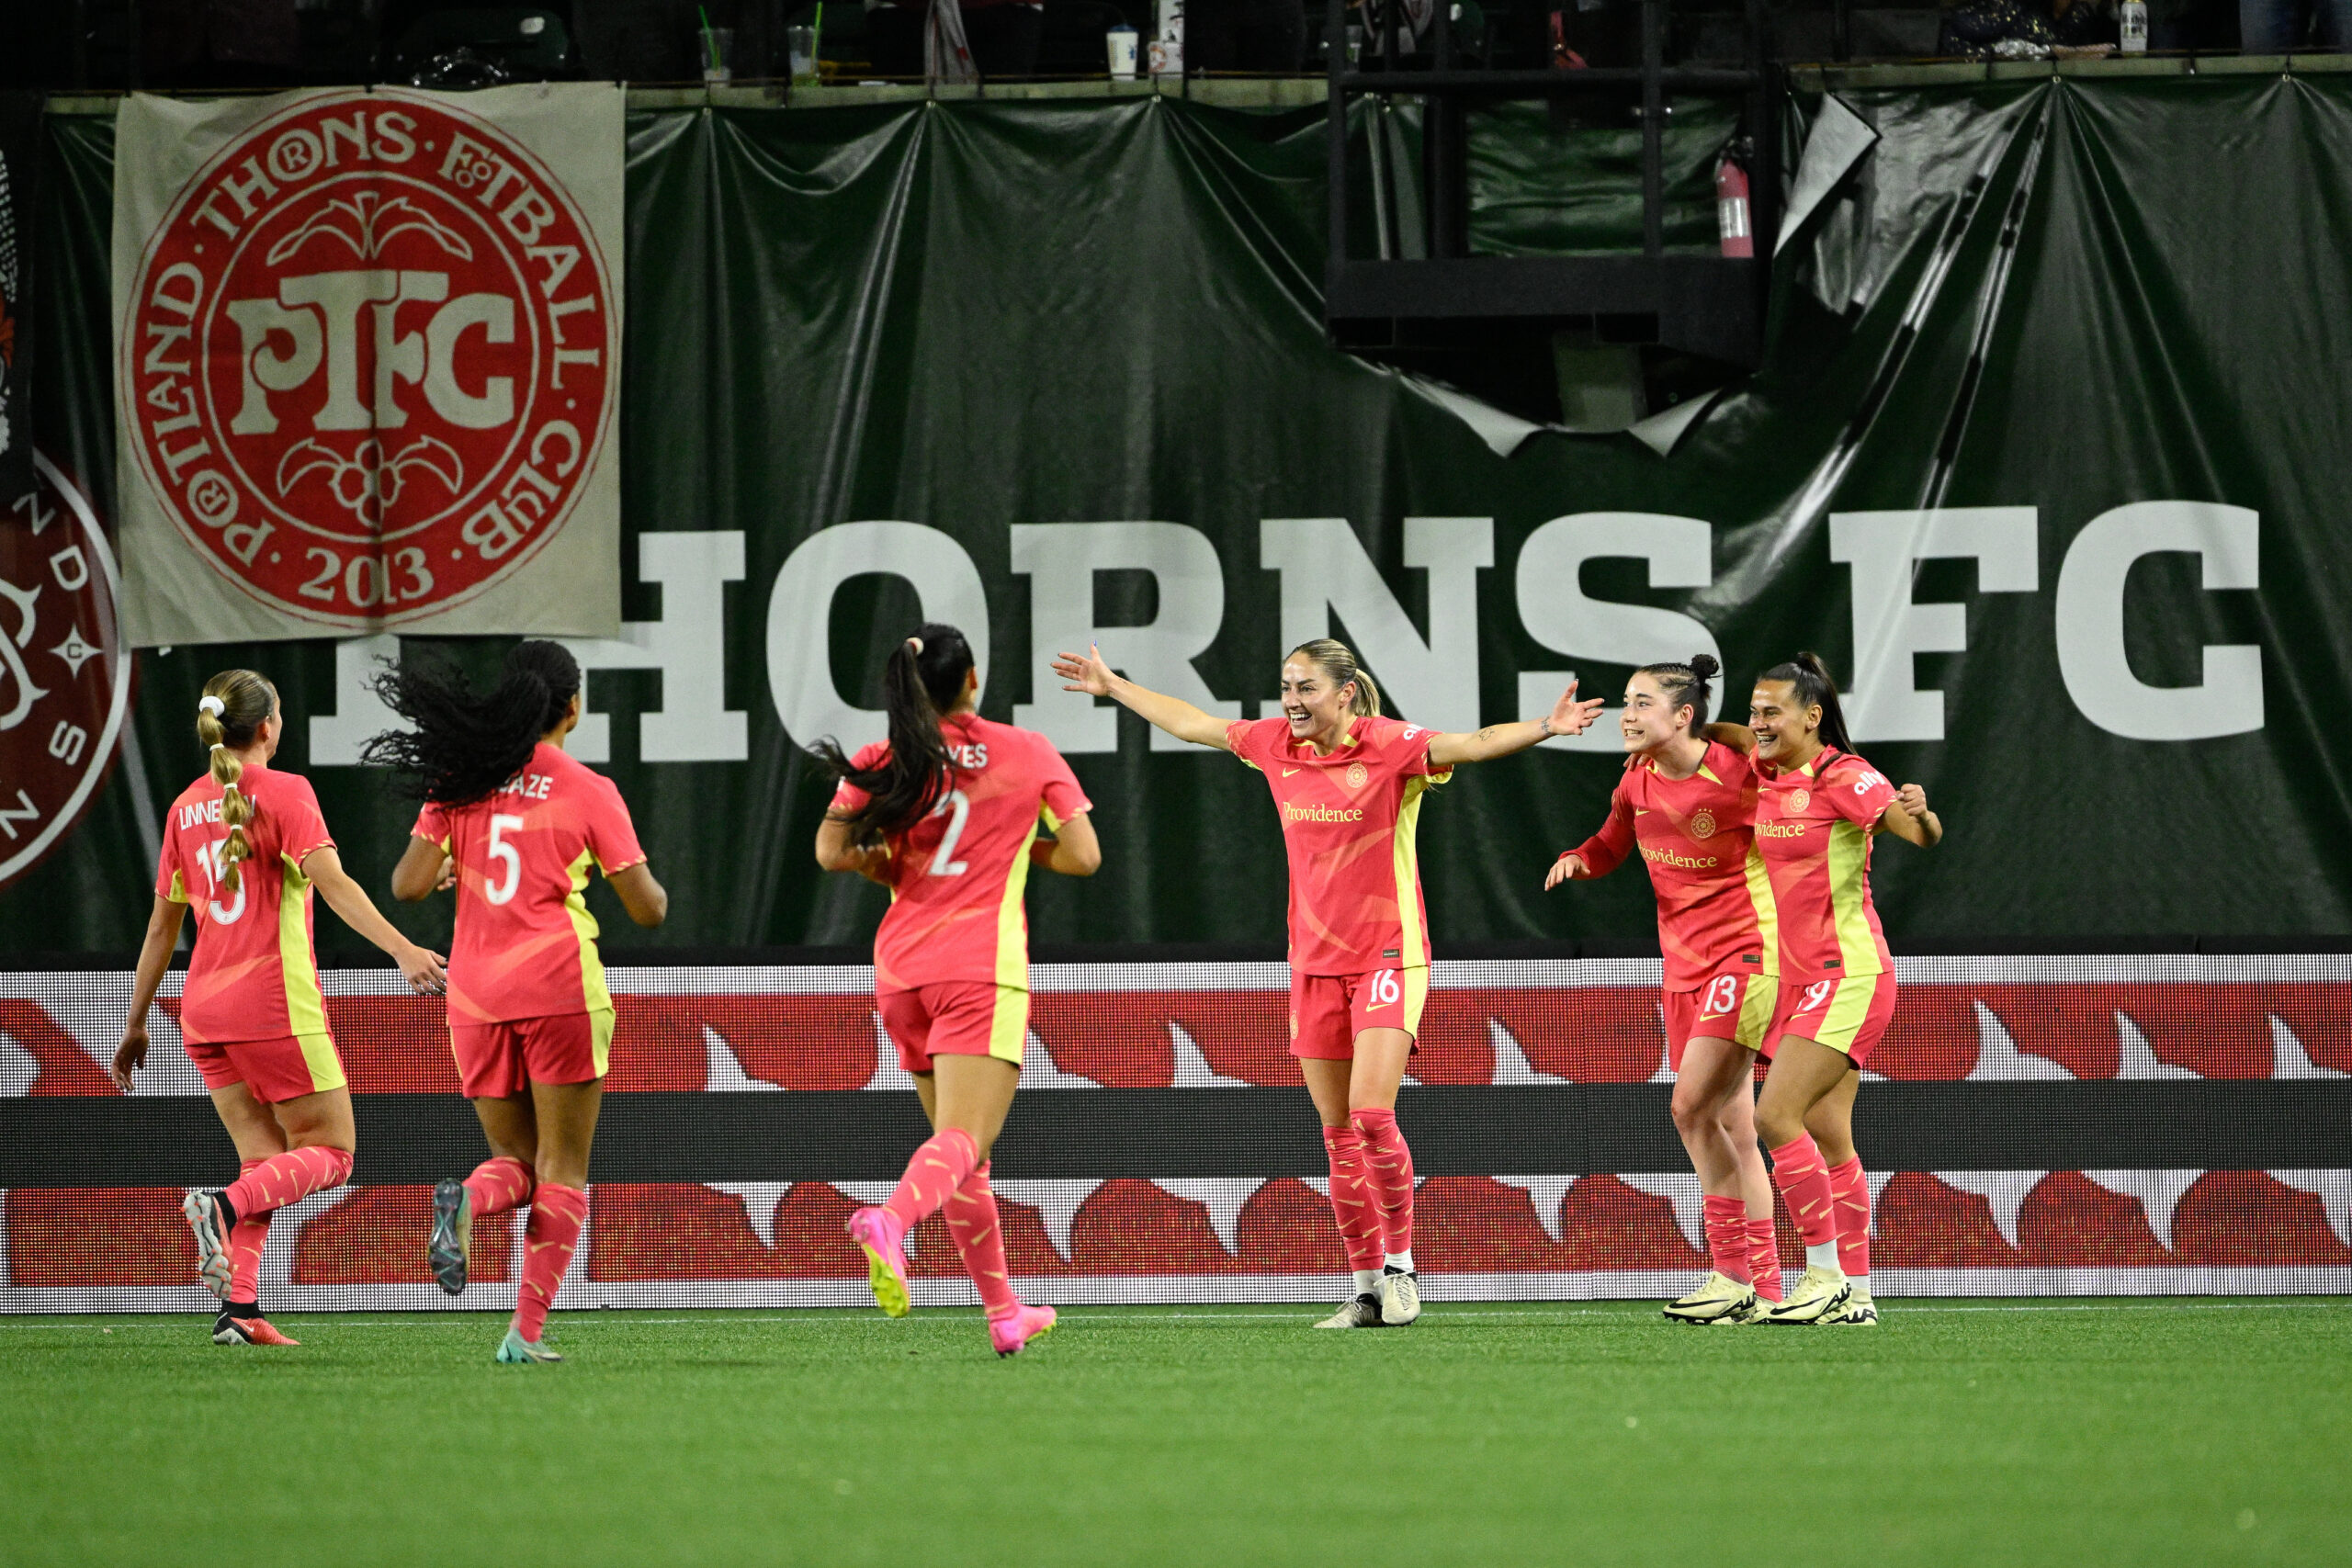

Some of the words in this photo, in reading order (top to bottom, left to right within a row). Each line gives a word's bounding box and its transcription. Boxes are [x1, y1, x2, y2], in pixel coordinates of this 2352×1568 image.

[299, 547, 435, 608] 2013
[1829, 500, 2265, 743] FC
[499, 773, 553, 800] AZE
[1853, 770, 1886, 795] ally
[1283, 801, 1363, 823] Providence
[1754, 819, 1805, 839] ovidence
[927, 788, 970, 877] 2
[484, 813, 525, 907] 5
[176, 837, 246, 926] 15
[1369, 968, 1400, 1004] 16
[1703, 975, 1737, 1013] 13
